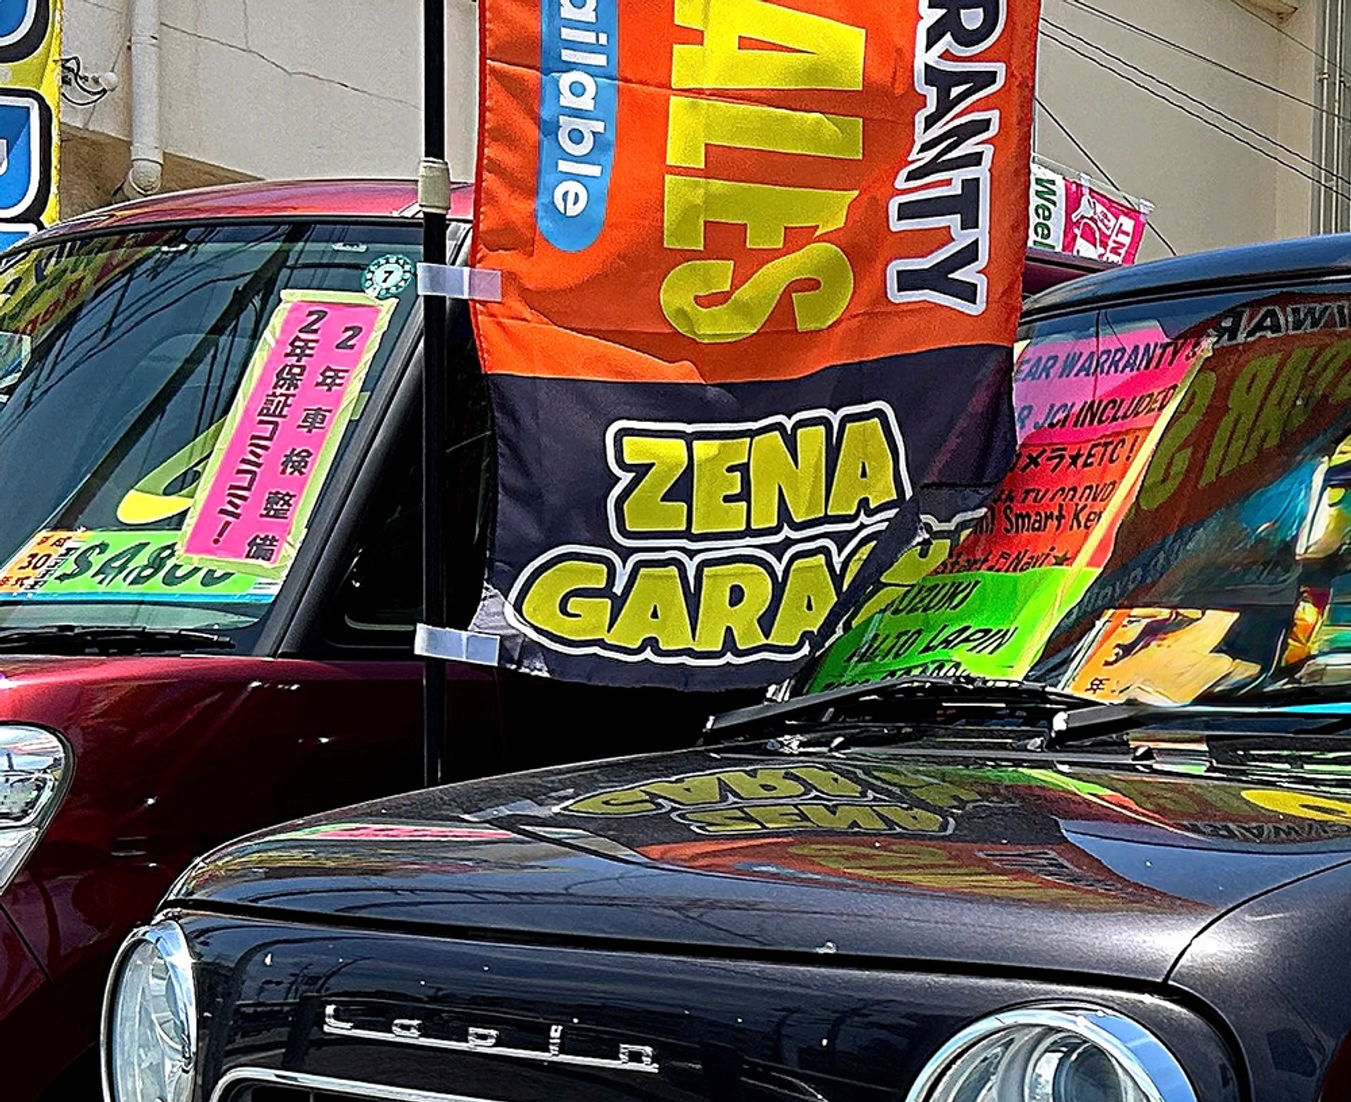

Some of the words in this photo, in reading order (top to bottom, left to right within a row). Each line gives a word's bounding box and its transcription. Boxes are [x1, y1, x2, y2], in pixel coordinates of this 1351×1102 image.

[660, 0, 866, 343] ALES
[382, 270, 394, 283] 7
[1058, 339, 1186, 379] WARRANTY
[1073, 383, 1180, 428] INCLUDED
[620, 416, 898, 535] ZENA
[1003, 503, 1065, 534] Smart
[18, 553, 52, 570] 30
[917, 623, 1019, 655] LAPIN
